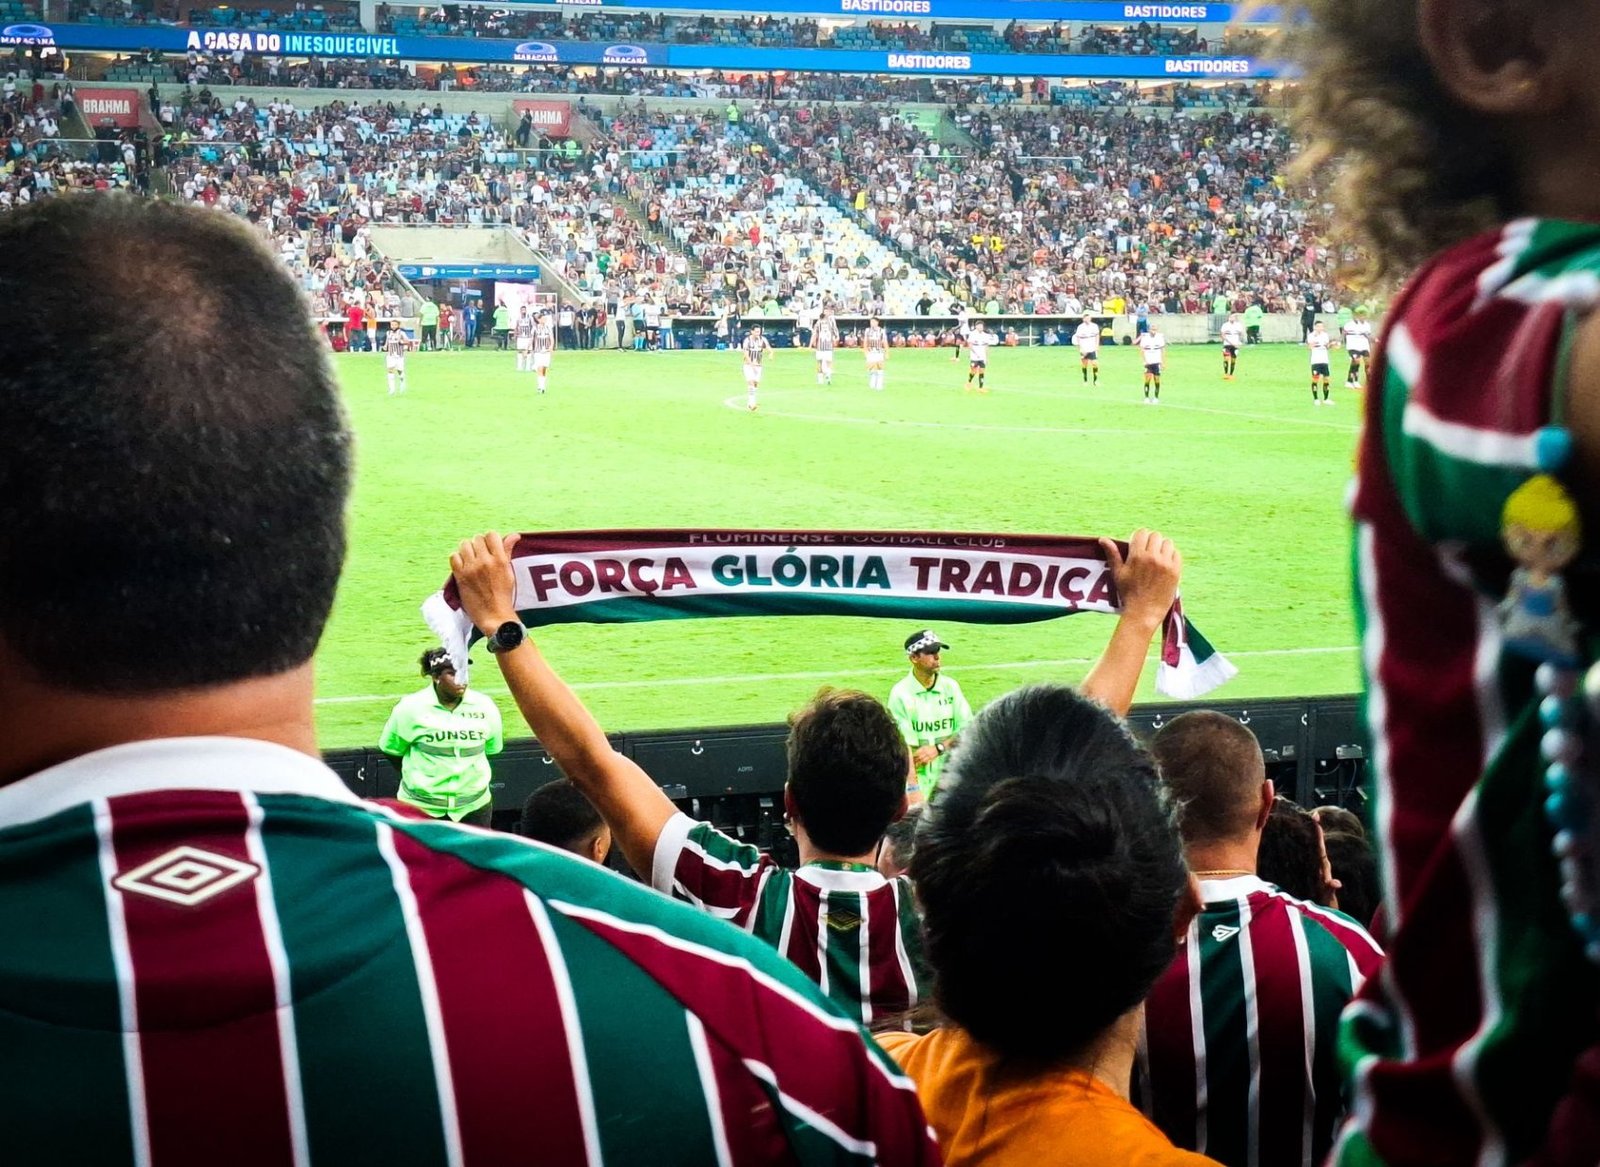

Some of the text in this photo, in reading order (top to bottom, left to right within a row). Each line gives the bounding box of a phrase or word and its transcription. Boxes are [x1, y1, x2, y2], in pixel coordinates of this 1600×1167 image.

[842, 0, 931, 13] BASTIDORES
[1123, 5, 1208, 19] BASTIDORES
[186, 30, 400, 56] A CASA DO INESQUECÍVEL
[887, 54, 972, 70] BASTIDORES
[1164, 60, 1249, 74] BASTIDORES
[83, 99, 131, 115] BRAHMA
[688, 533, 836, 544] FLUMINENSE
[528, 556, 698, 601] FORÇA
[711, 546, 892, 589] GLÓRIA
